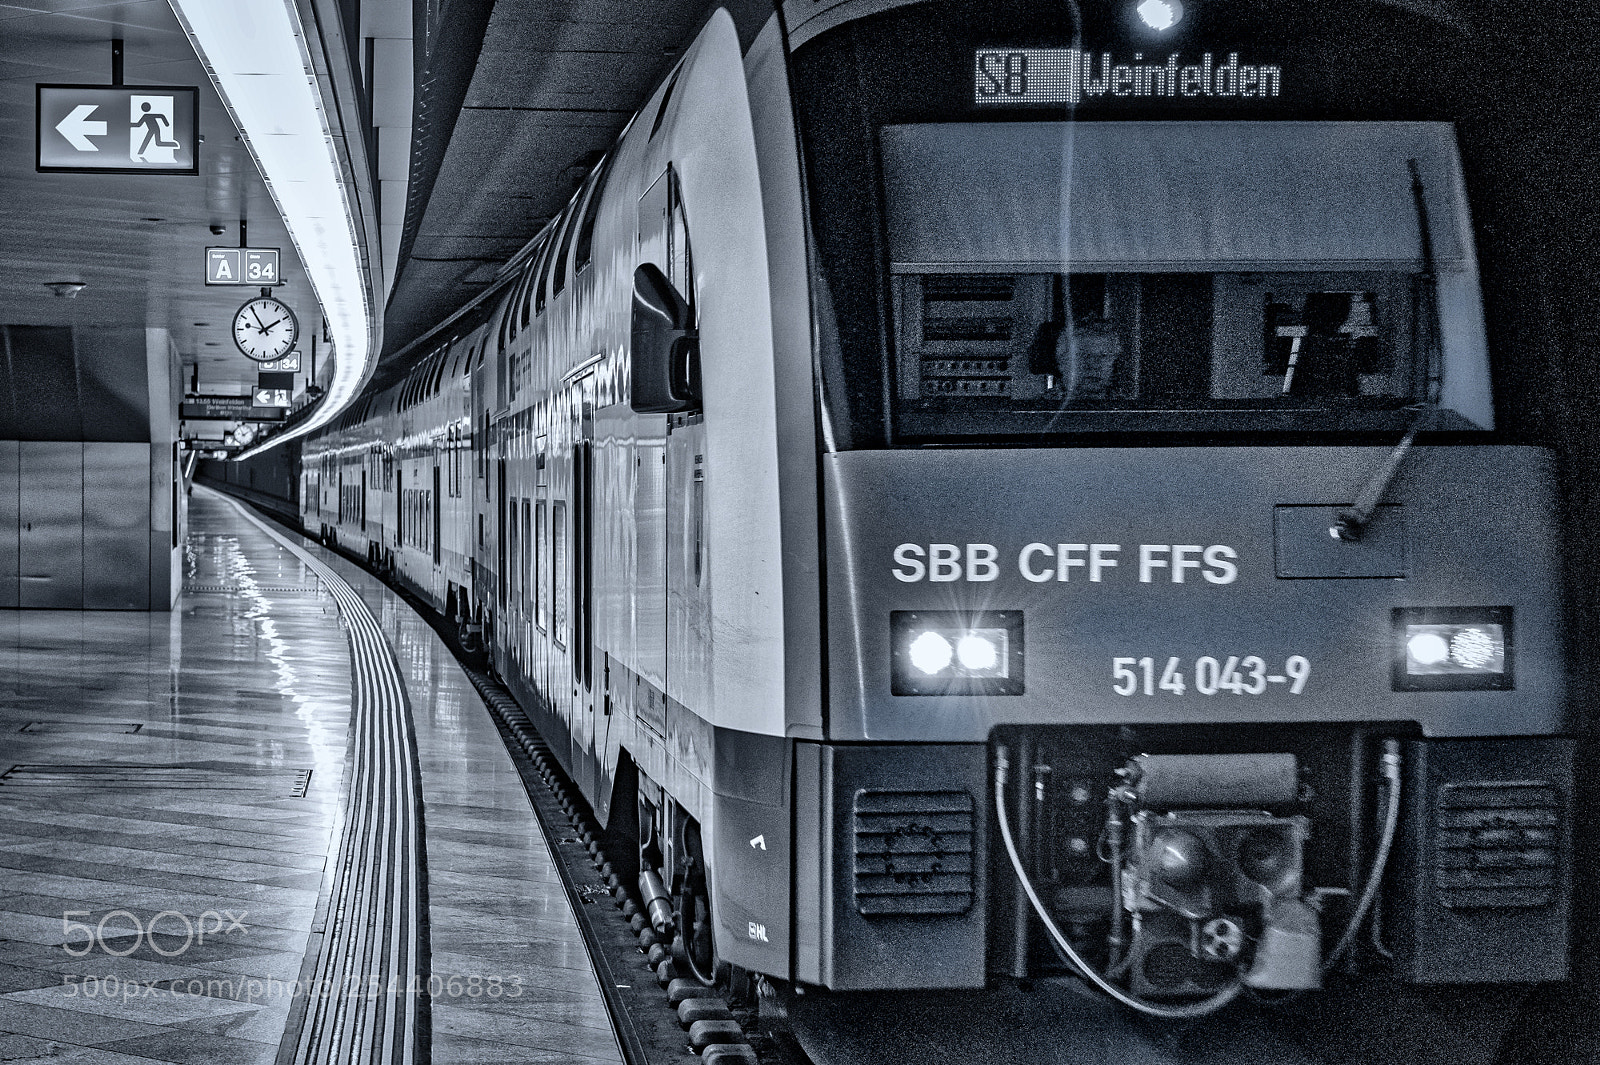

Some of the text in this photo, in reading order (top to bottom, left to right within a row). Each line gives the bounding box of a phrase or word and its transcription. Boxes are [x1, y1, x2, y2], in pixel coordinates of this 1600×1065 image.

[978, 52, 1281, 97] S8 Weinfelden
[216, 259, 232, 279] A
[249, 262, 274, 279] 34
[282, 358, 298, 369] 34
[892, 543, 1238, 585] SBB CFF FFS
[1112, 655, 1311, 696] 514 043-9
